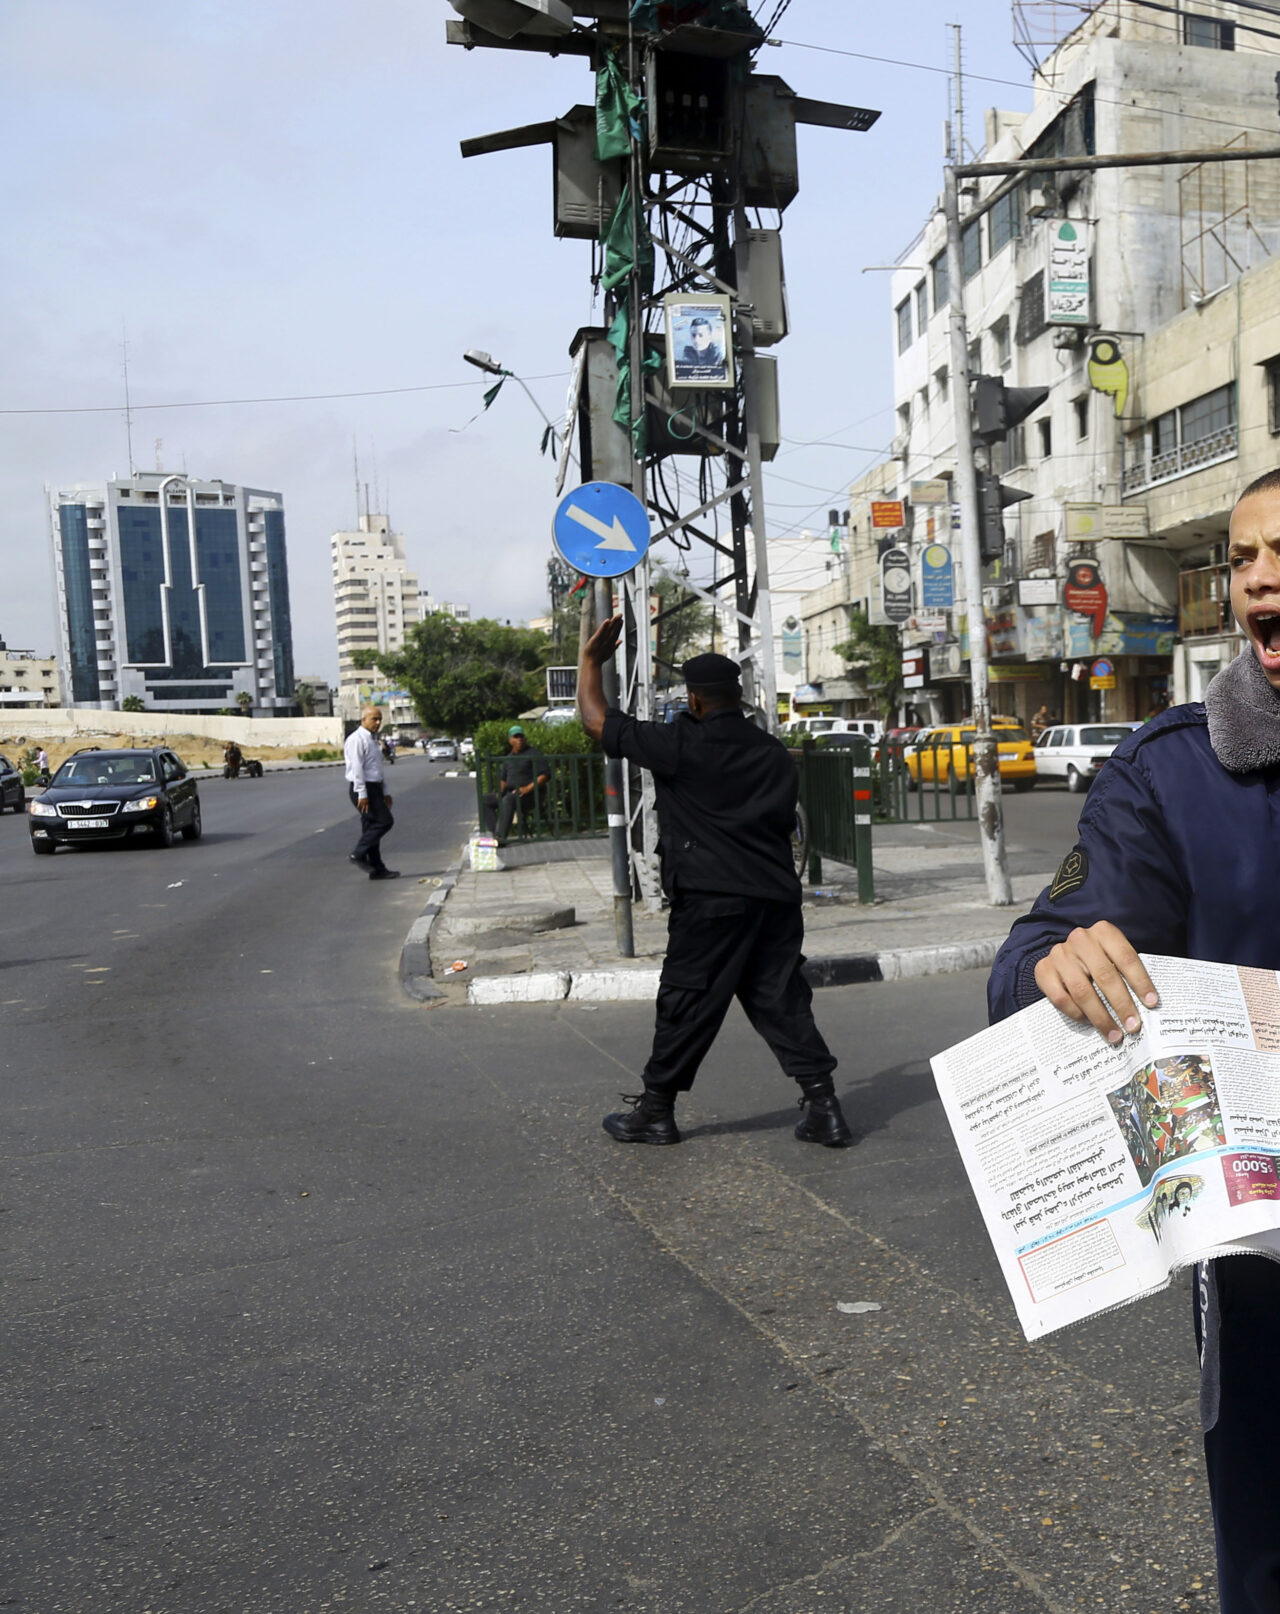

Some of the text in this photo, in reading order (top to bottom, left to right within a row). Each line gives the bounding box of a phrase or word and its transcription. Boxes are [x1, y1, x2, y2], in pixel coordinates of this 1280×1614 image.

[1001, 1154, 1126, 1220] باتفاق المصالحة ويعد بمواصلة الدعم
[1010, 1146, 1105, 1201] للقضية والشعب الفلسطيني
[1232, 1157, 1272, 1175] $5,000
[1013, 1216, 1027, 1234] أمير
[1029, 1209, 1043, 1226] قطر
[1069, 1186, 1095, 1207] الرئيس
[1097, 1172, 1124, 1191] ومشعل
